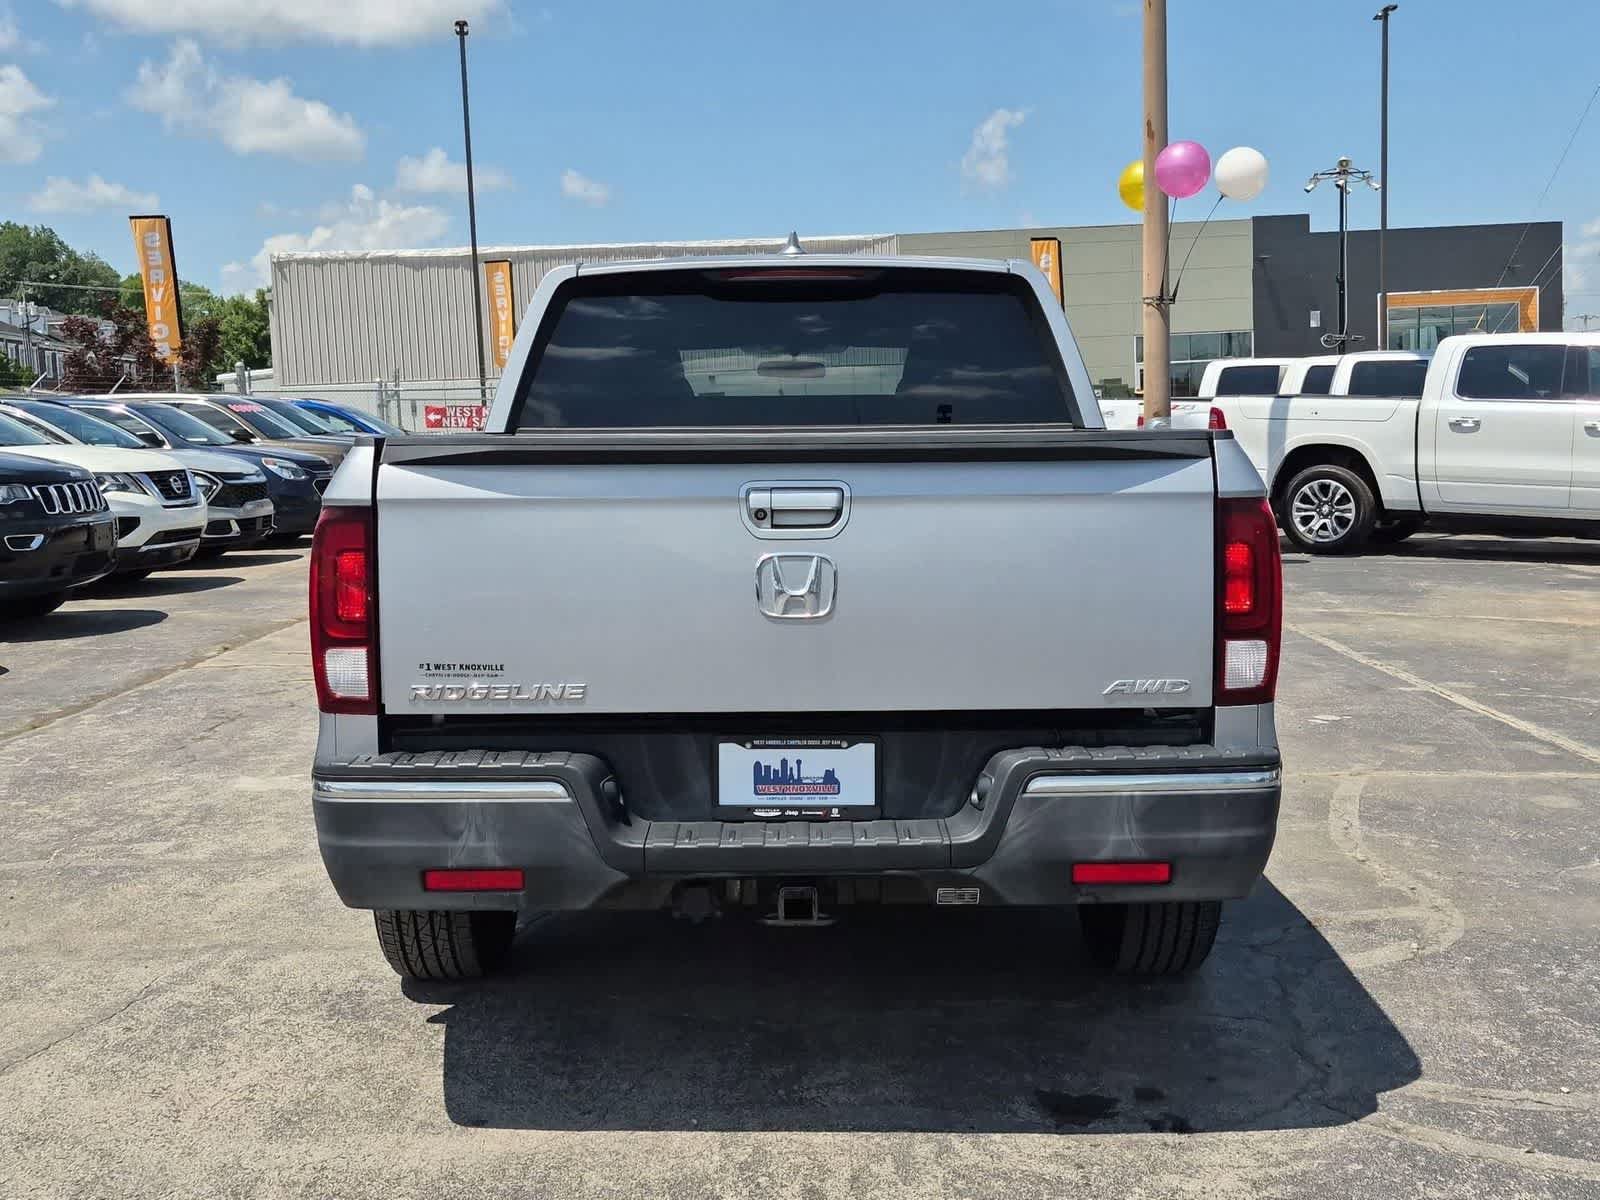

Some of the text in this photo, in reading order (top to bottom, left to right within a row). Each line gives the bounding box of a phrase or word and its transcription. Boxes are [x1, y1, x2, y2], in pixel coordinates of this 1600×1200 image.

[446, 406, 478, 417] WEST
[442, 417, 468, 427] NEW
[434, 663, 456, 671] WEST
[459, 663, 504, 671] KNOXVILLE
[409, 682, 588, 701] RIDGELINE
[1101, 679, 1191, 695] AWD
